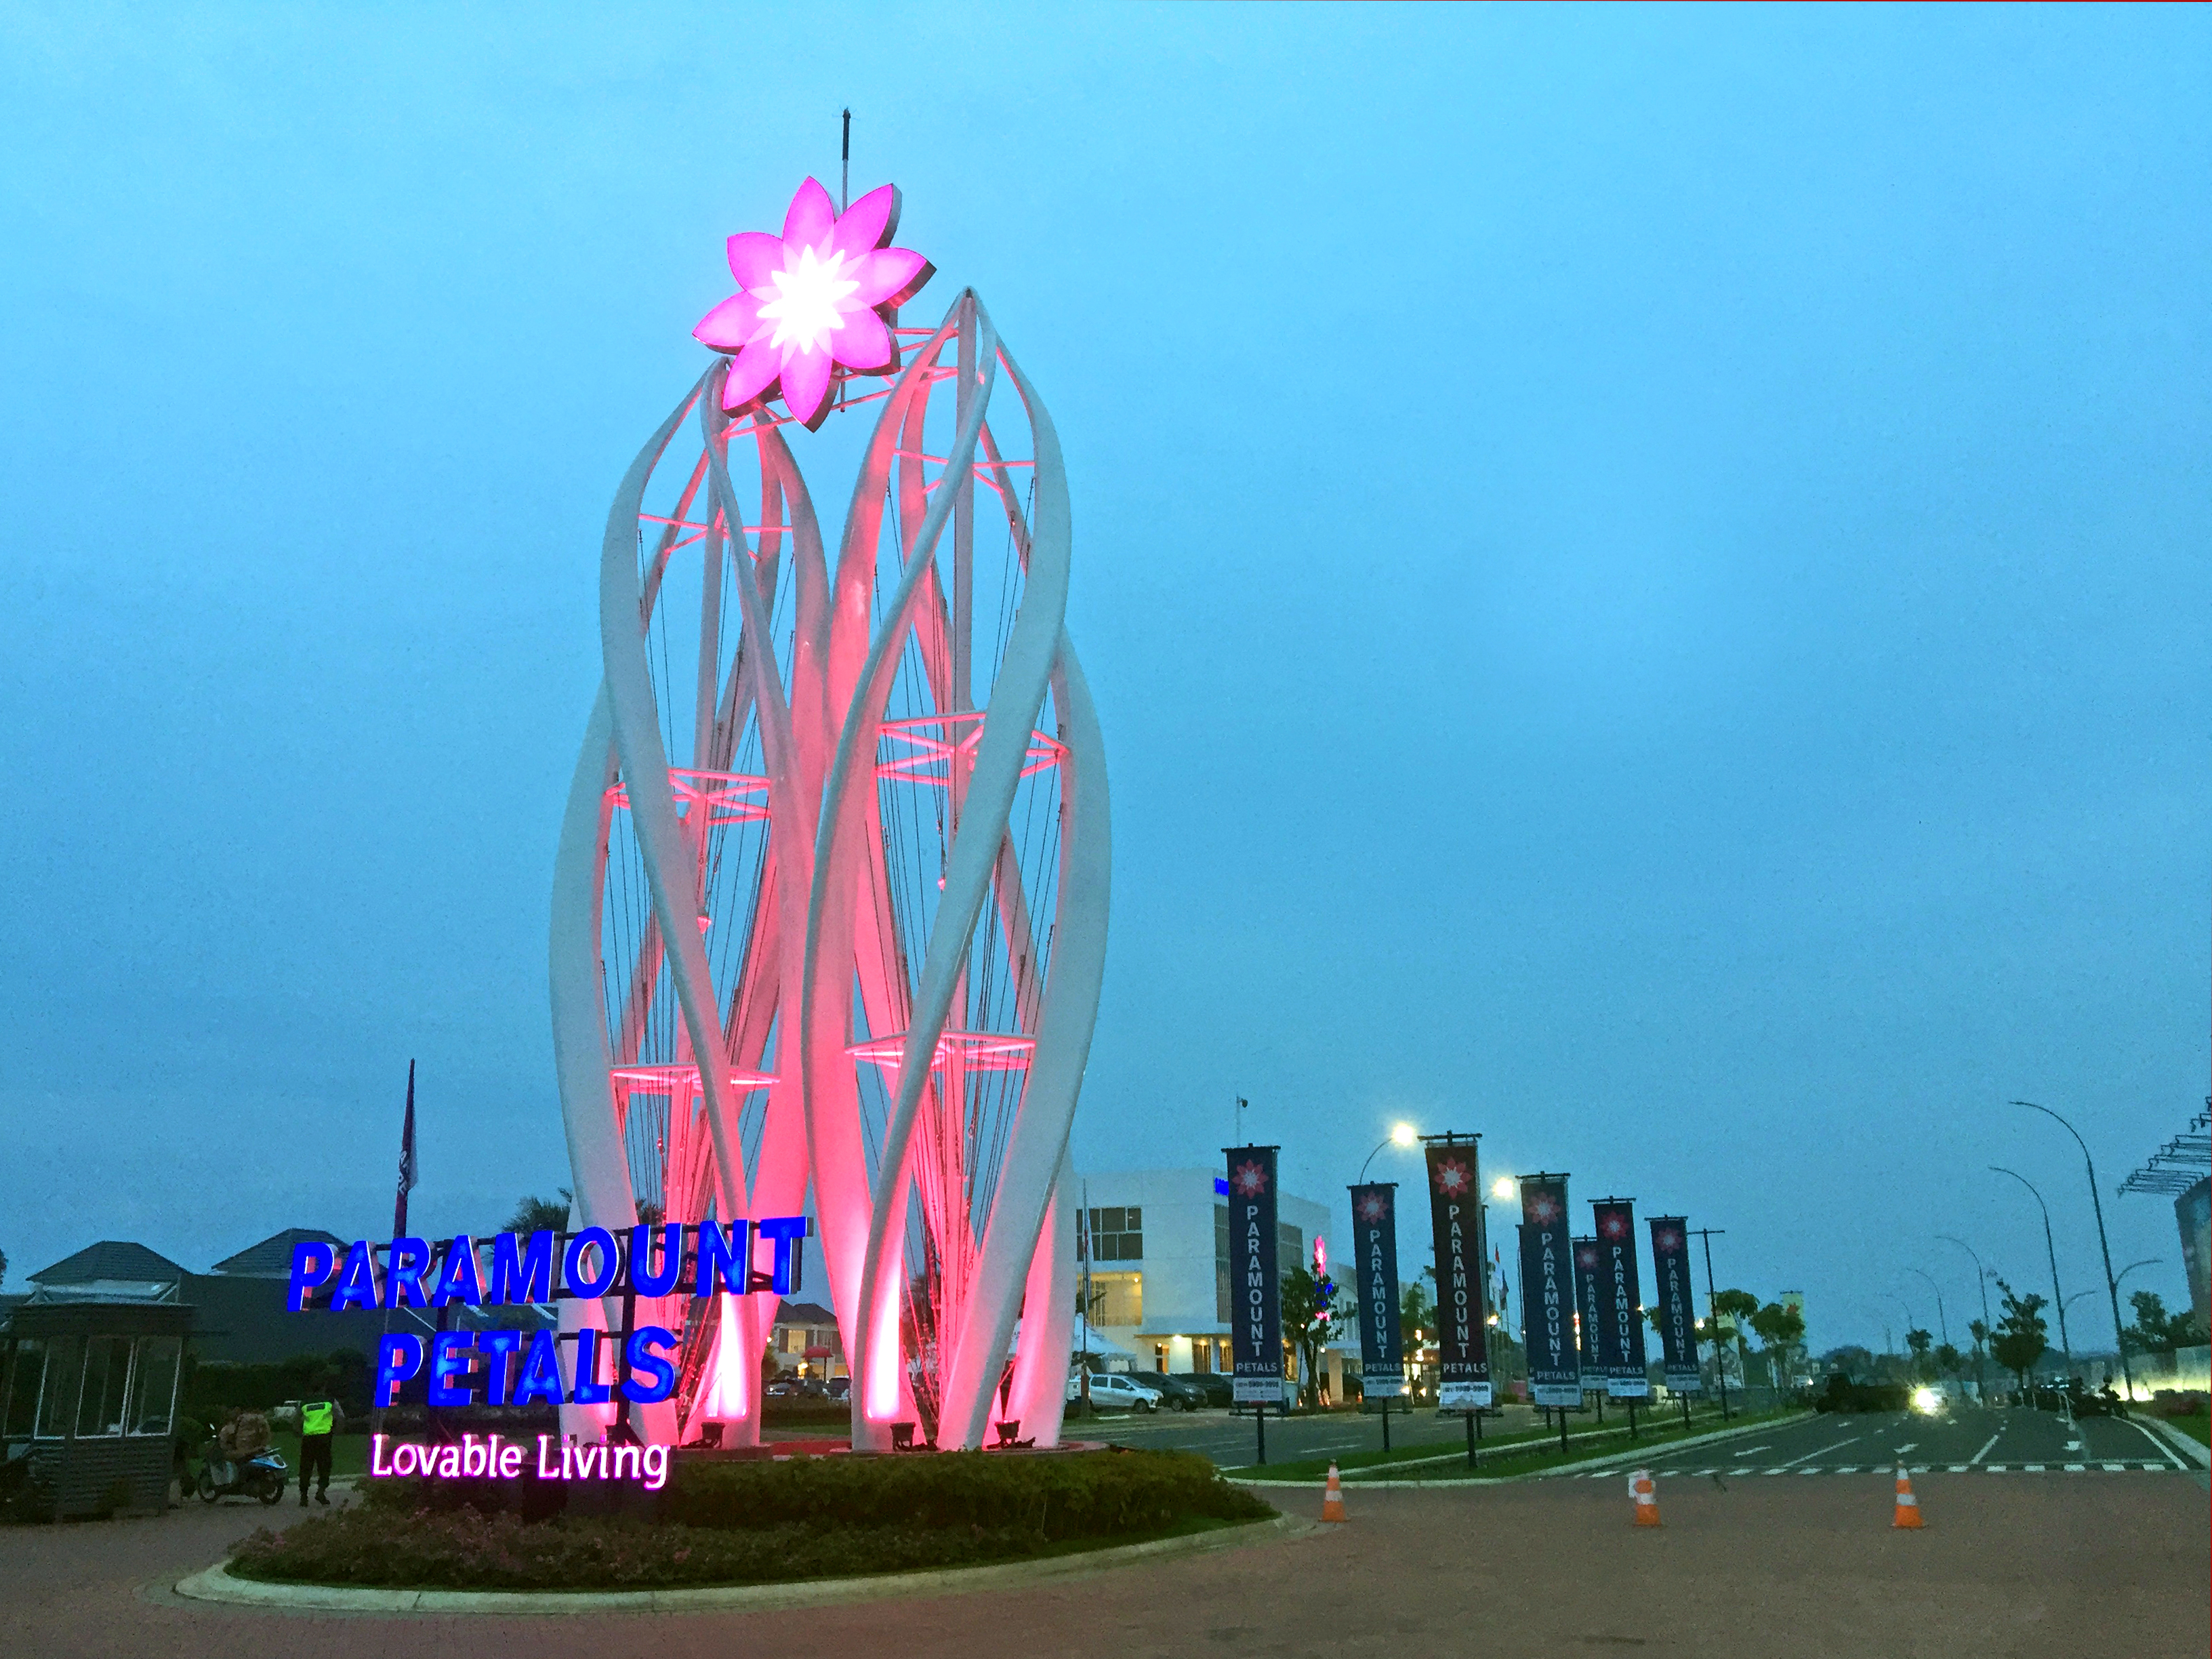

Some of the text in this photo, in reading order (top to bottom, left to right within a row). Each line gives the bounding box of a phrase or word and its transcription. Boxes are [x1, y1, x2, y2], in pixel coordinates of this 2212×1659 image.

[287, 1216, 812, 1312] PARAMOUNT
[1246, 1205, 1263, 1357] PARAMOUNT
[1370, 1229, 1387, 1358] PARAMOUNT
[1449, 1205, 1469, 1359] PARAMOUNT
[1542, 1232, 1561, 1366] PARAMOUNT
[1613, 1246, 1631, 1362] PARAMOUNT
[1667, 1258, 1685, 1361] PARAMOUNT
[1586, 1273, 1599, 1364] PARAMOUNT
[375, 1326, 680, 1408] PETALS
[1236, 1362, 1277, 1372] PETALS
[1365, 1363, 1401, 1372] PETALS
[1443, 1362, 1488, 1373] PETALS
[1536, 1371, 1576, 1380] PETALS
[1610, 1366, 1643, 1374] PETALS
[371, 1433, 670, 1490] Lovable Living
